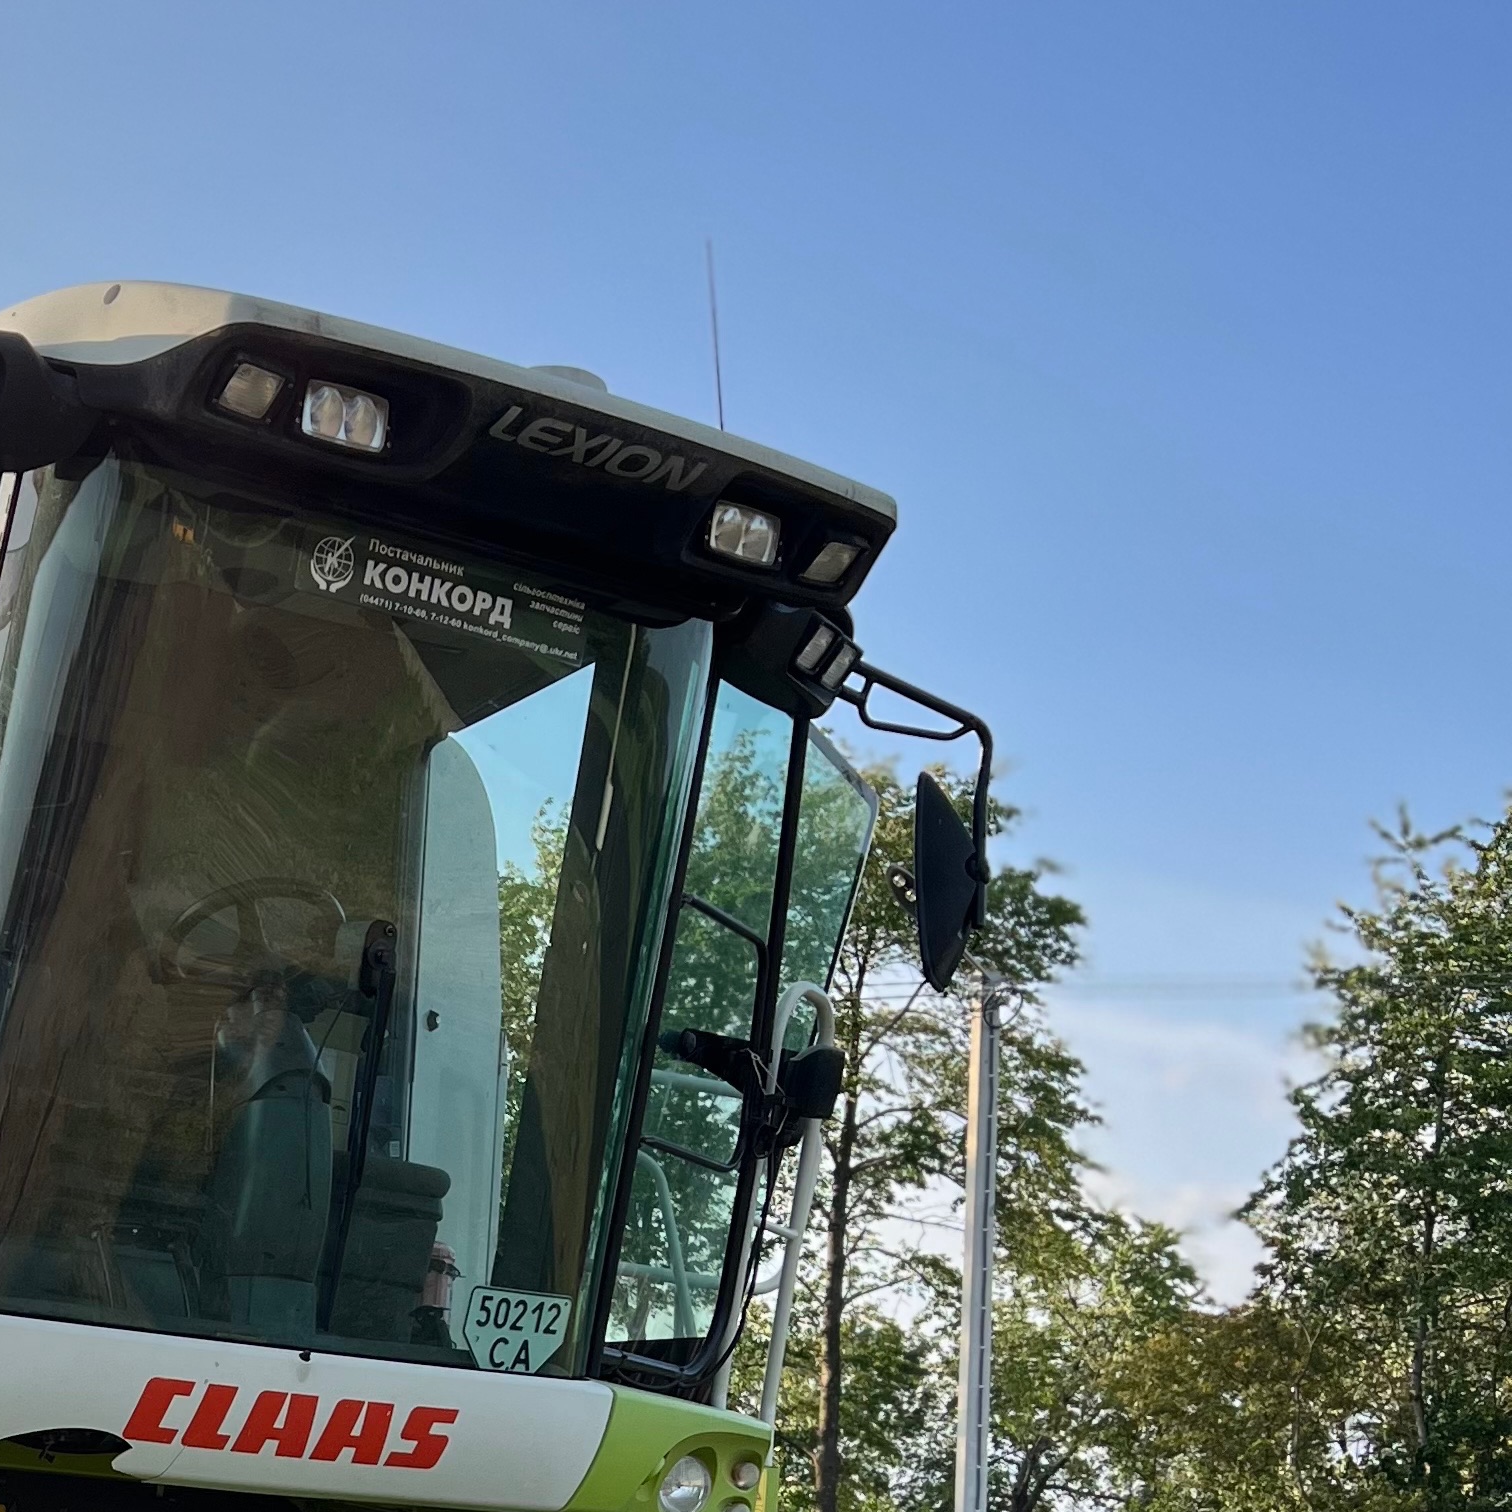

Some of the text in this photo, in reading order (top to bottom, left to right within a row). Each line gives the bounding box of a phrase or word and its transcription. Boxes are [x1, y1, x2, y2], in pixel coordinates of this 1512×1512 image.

[488, 405, 708, 492] LEXION
[369, 538, 465, 577] Постачальник
[359, 593, 393, 611] (04471)
[363, 559, 514, 630] КОНКОРД
[475, 1295, 562, 1335] 50212
[489, 1337, 530, 1371] CA
[123, 1376, 459, 1469] CLAAS
